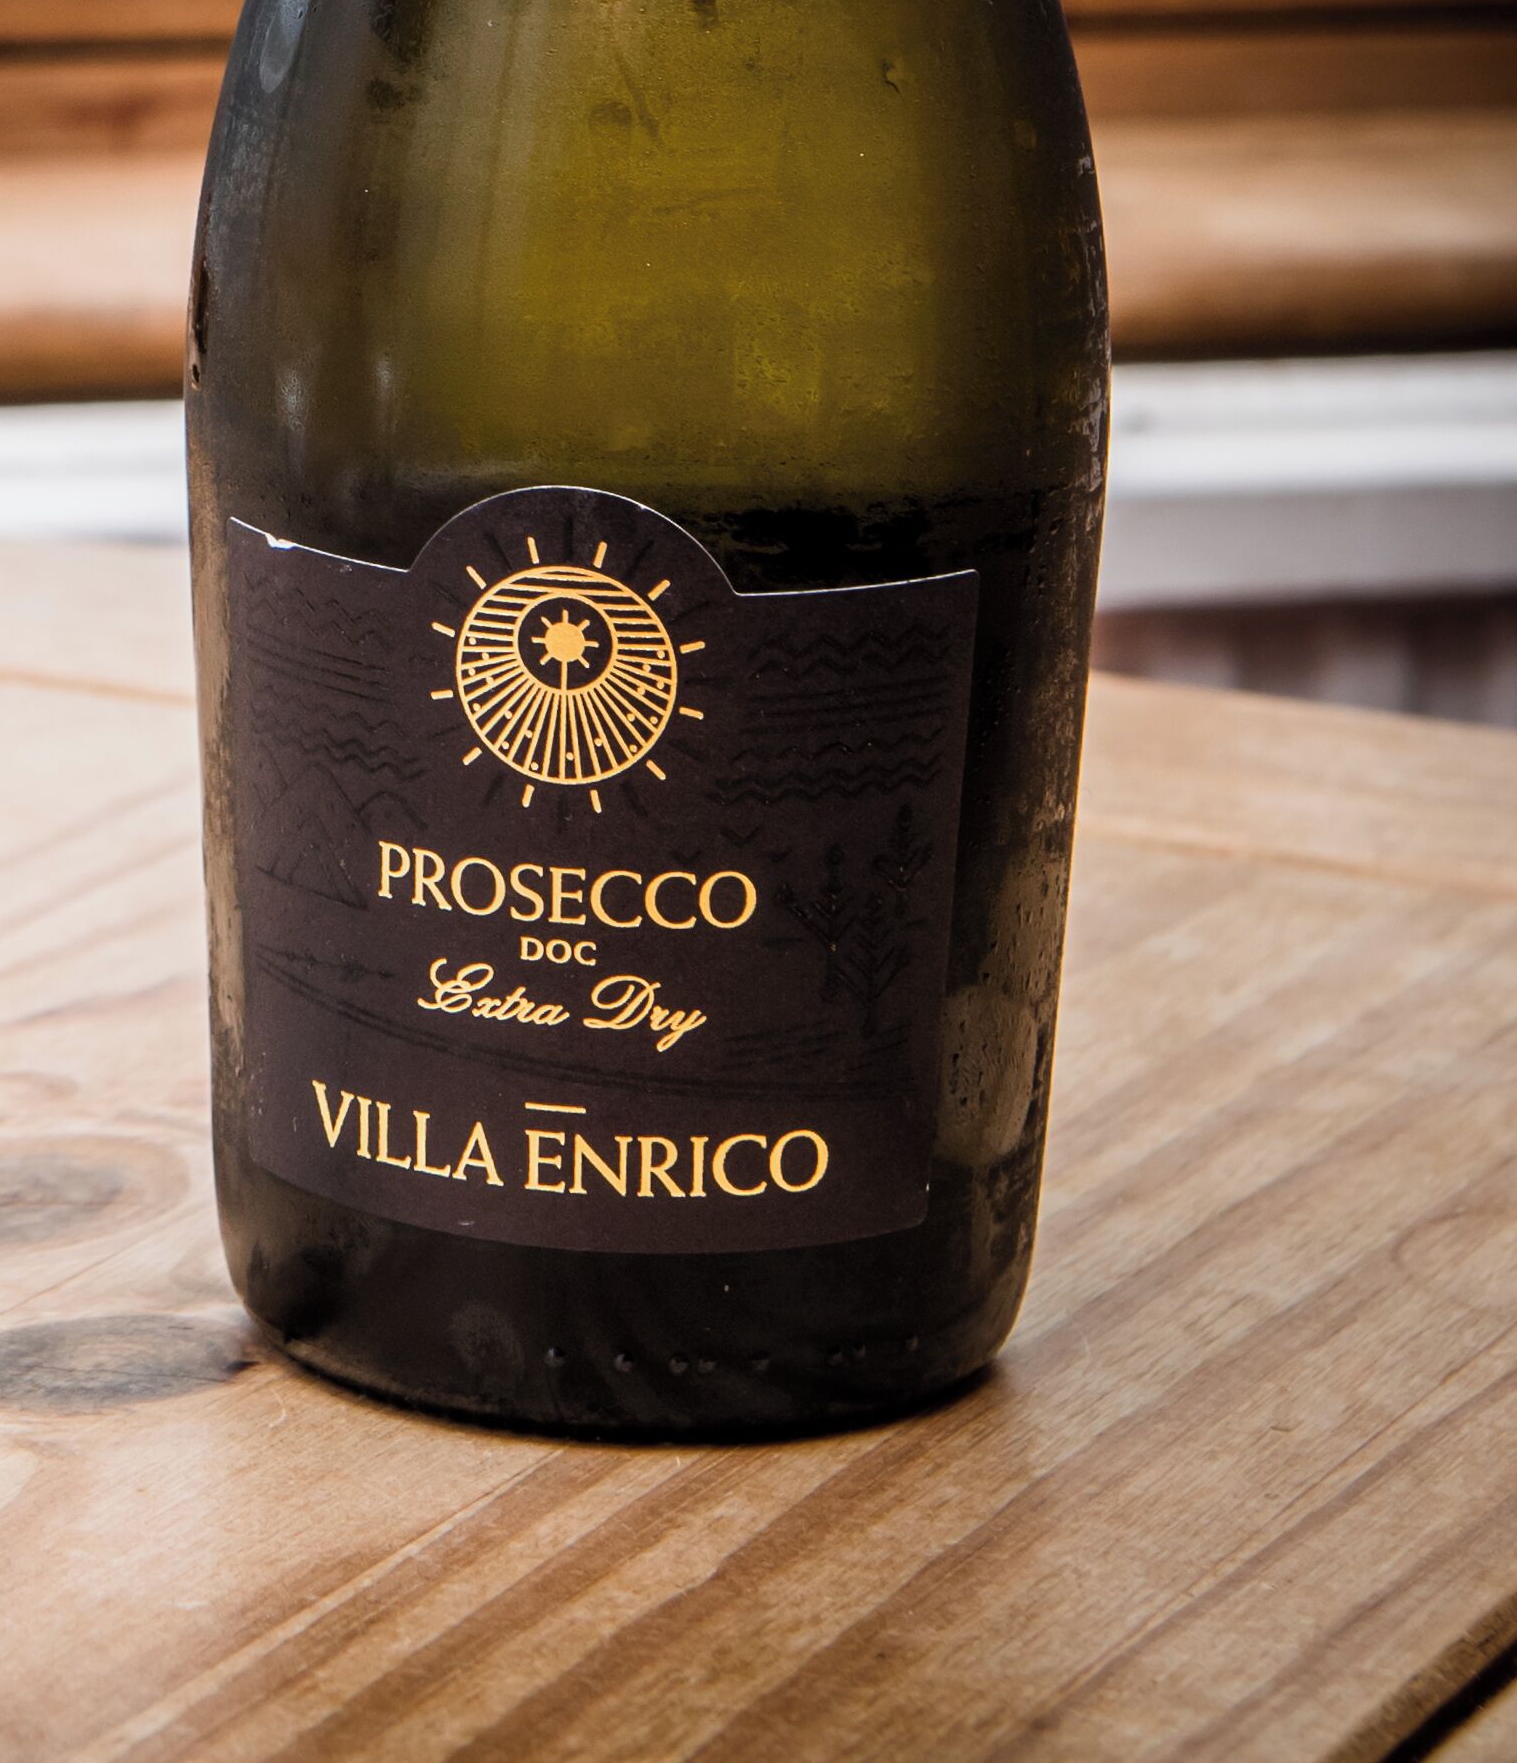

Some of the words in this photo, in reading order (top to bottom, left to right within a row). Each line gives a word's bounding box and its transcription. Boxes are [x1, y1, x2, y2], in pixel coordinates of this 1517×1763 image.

[377, 840, 758, 930] PROSECCO
[519, 935, 597, 966] DOC
[417, 958, 570, 1028] Extra
[582, 974, 708, 1053] Dry
[311, 1080, 504, 1188] VILLA
